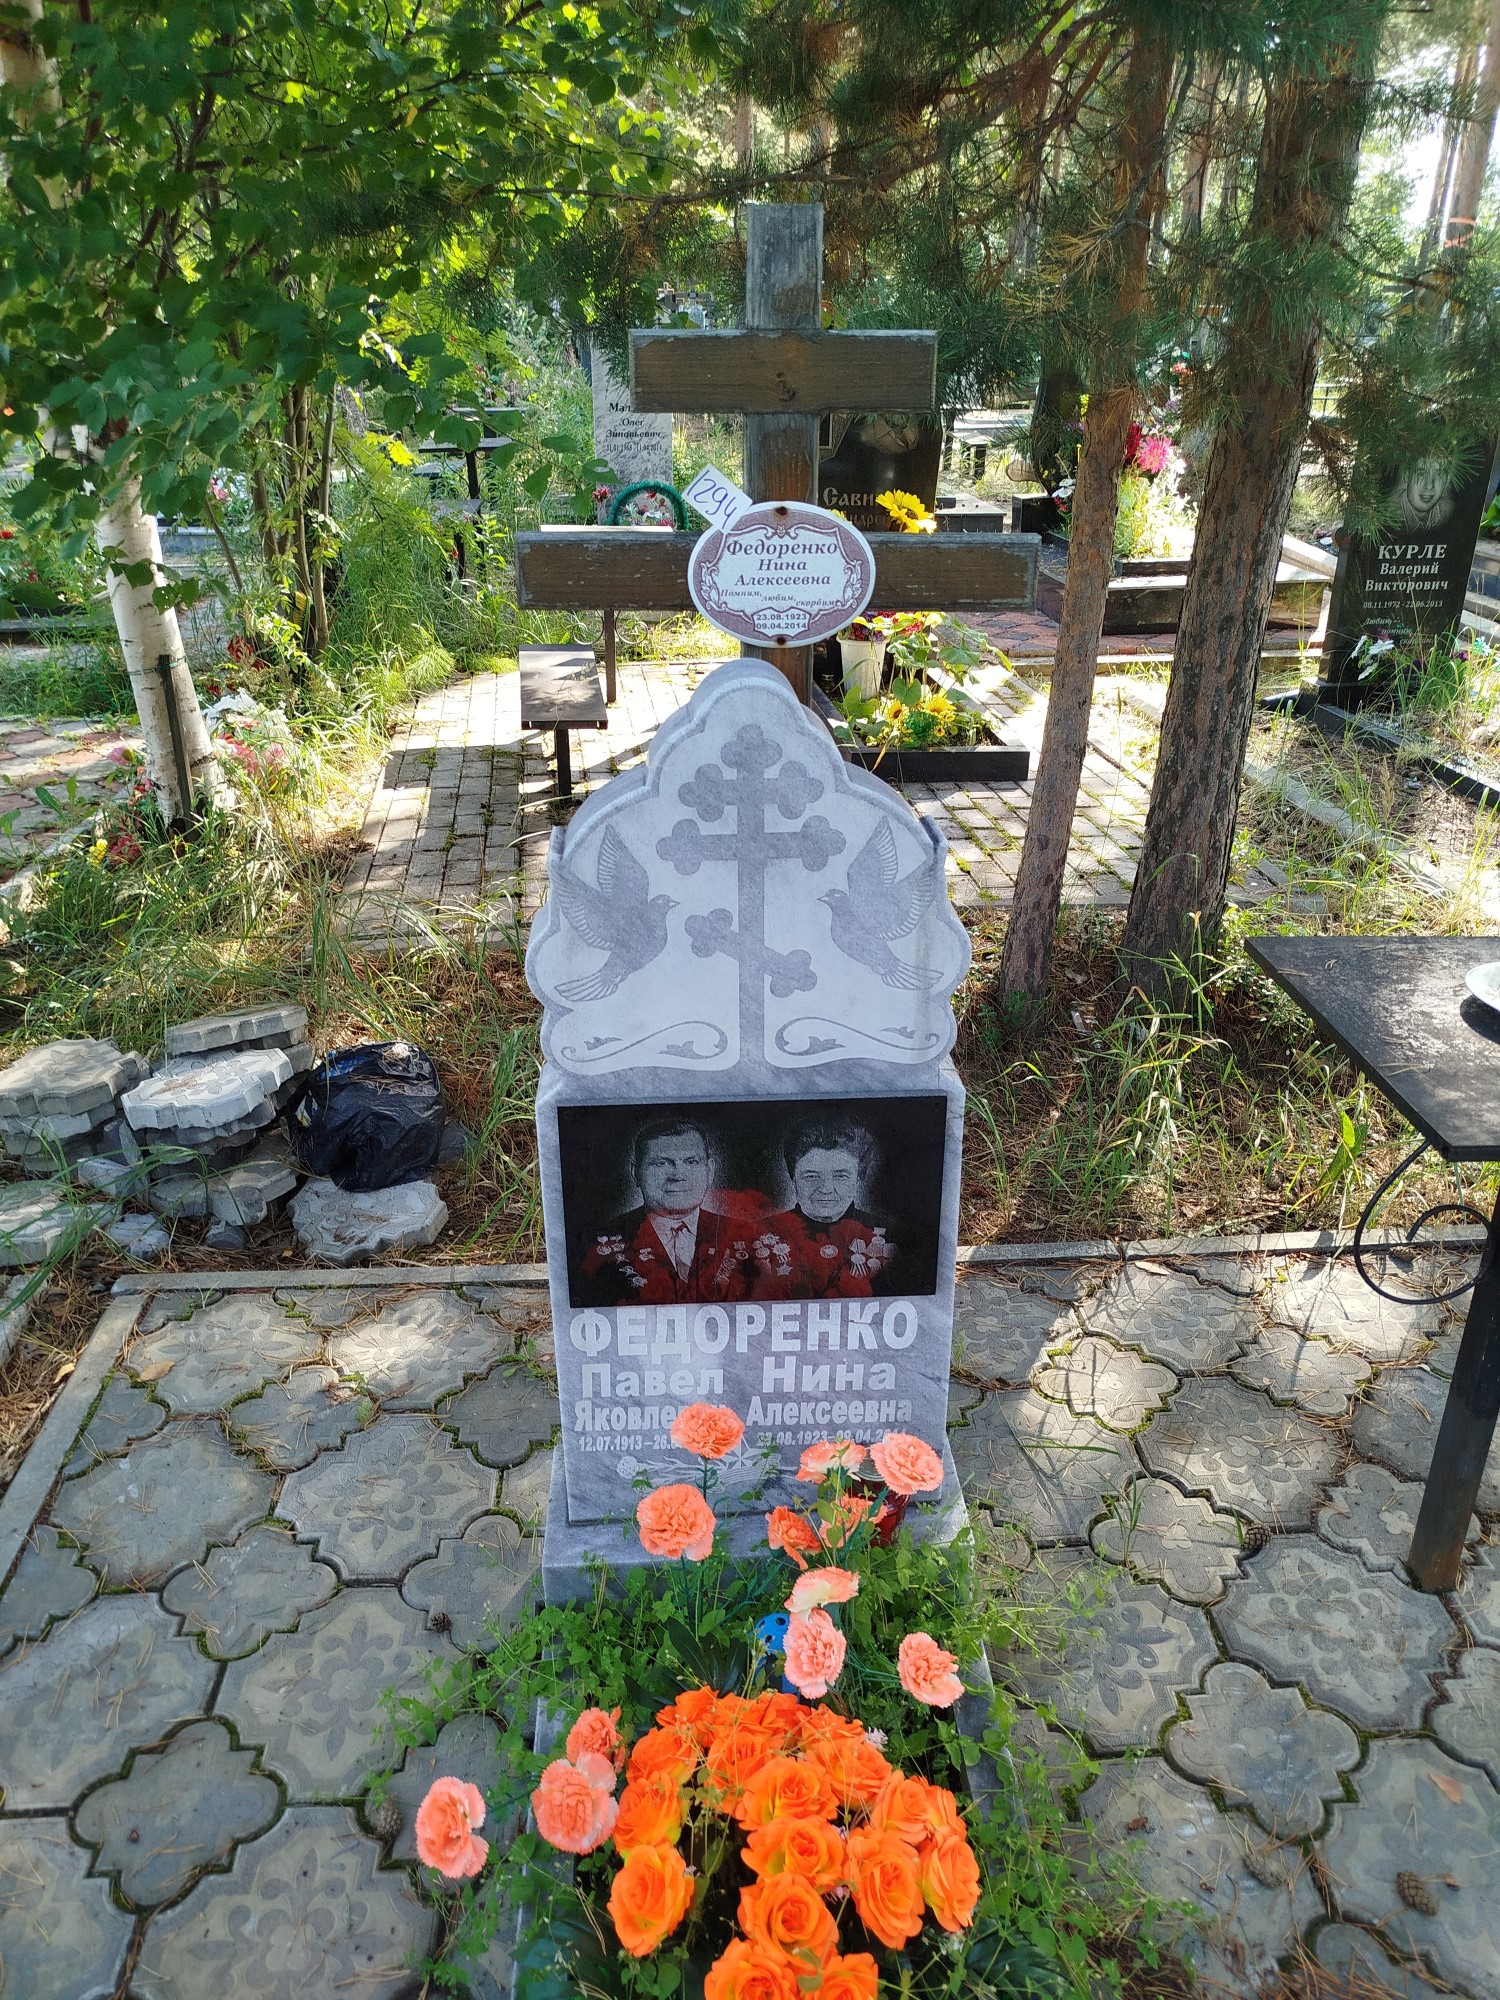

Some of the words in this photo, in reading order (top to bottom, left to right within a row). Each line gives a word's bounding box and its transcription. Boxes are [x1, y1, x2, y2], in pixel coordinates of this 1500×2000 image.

[608, 402, 631, 412] Мал
[622, 417, 645, 427] Олег
[605, 430, 662, 438] Зиновьевич
[686, 469, 738, 530] 1294
[822, 486, 880, 507] Сави
[726, 538, 838, 560] Федоренко
[1377, 544, 1448, 560] КУРЛЕ
[757, 558, 808, 572] Нина
[1379, 562, 1439, 578] Валерий
[734, 573, 831, 586] Алексеевна
[1364, 580, 1449, 593] Викторович
[720, 589, 763, 598] Помним,
[761, 594, 797, 602] любим,
[1405, 600, 1444, 608] 2206.2013
[756, 613, 807, 621] 23.08.1923
[756, 622, 807, 630] 09.04.2014
[569, 1299, 919, 1364] ФЕДОРЕНКО
[581, 1363, 725, 1399] Павел
[762, 1356, 897, 1393] Нина
[574, 1399, 726, 1432] Яковле
[745, 1395, 913, 1427] Алексеевна
